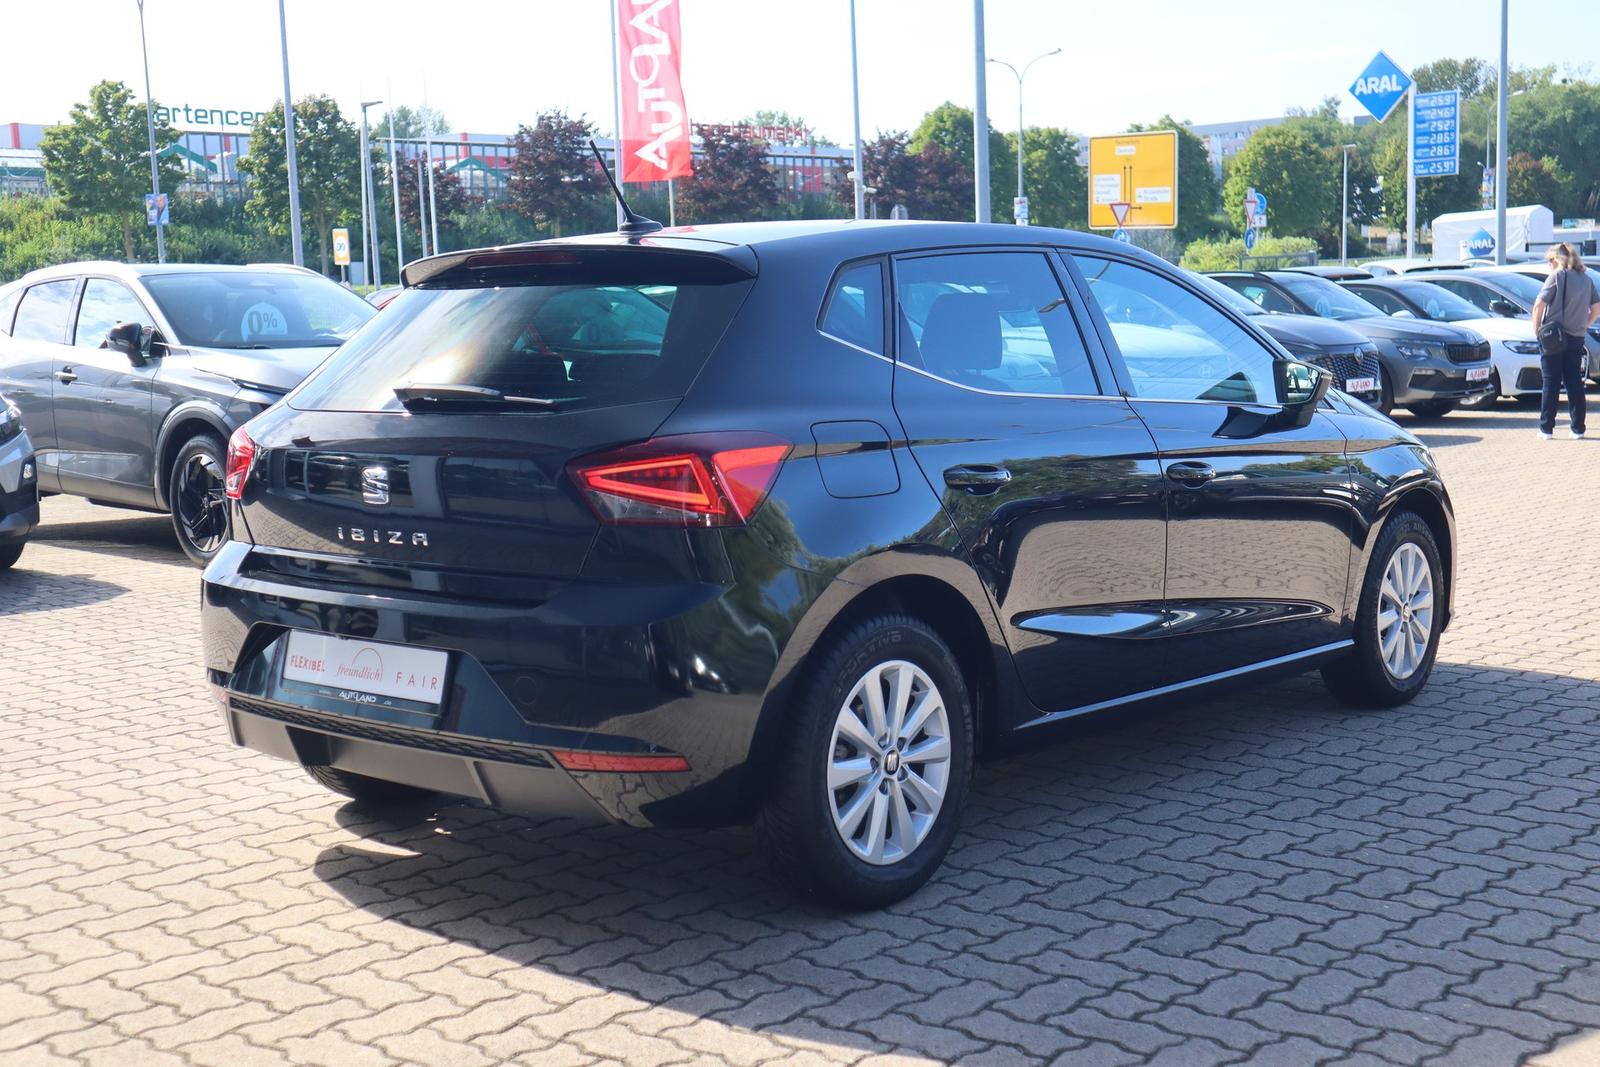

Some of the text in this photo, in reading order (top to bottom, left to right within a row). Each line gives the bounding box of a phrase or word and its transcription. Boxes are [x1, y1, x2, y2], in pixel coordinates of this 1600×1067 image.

[629, 0, 683, 170] AUTOLA
[1355, 74, 1403, 96] ARAL
[1468, 238, 1495, 249] ARAL
[247, 310, 278, 334] 0%
[338, 527, 428, 546] IBIZA
[289, 655, 326, 673] FLEXIBEL
[336, 663, 382, 682] freundlich
[395, 671, 438, 690] FAIR
[338, 690, 377, 703] AUTOLAND
